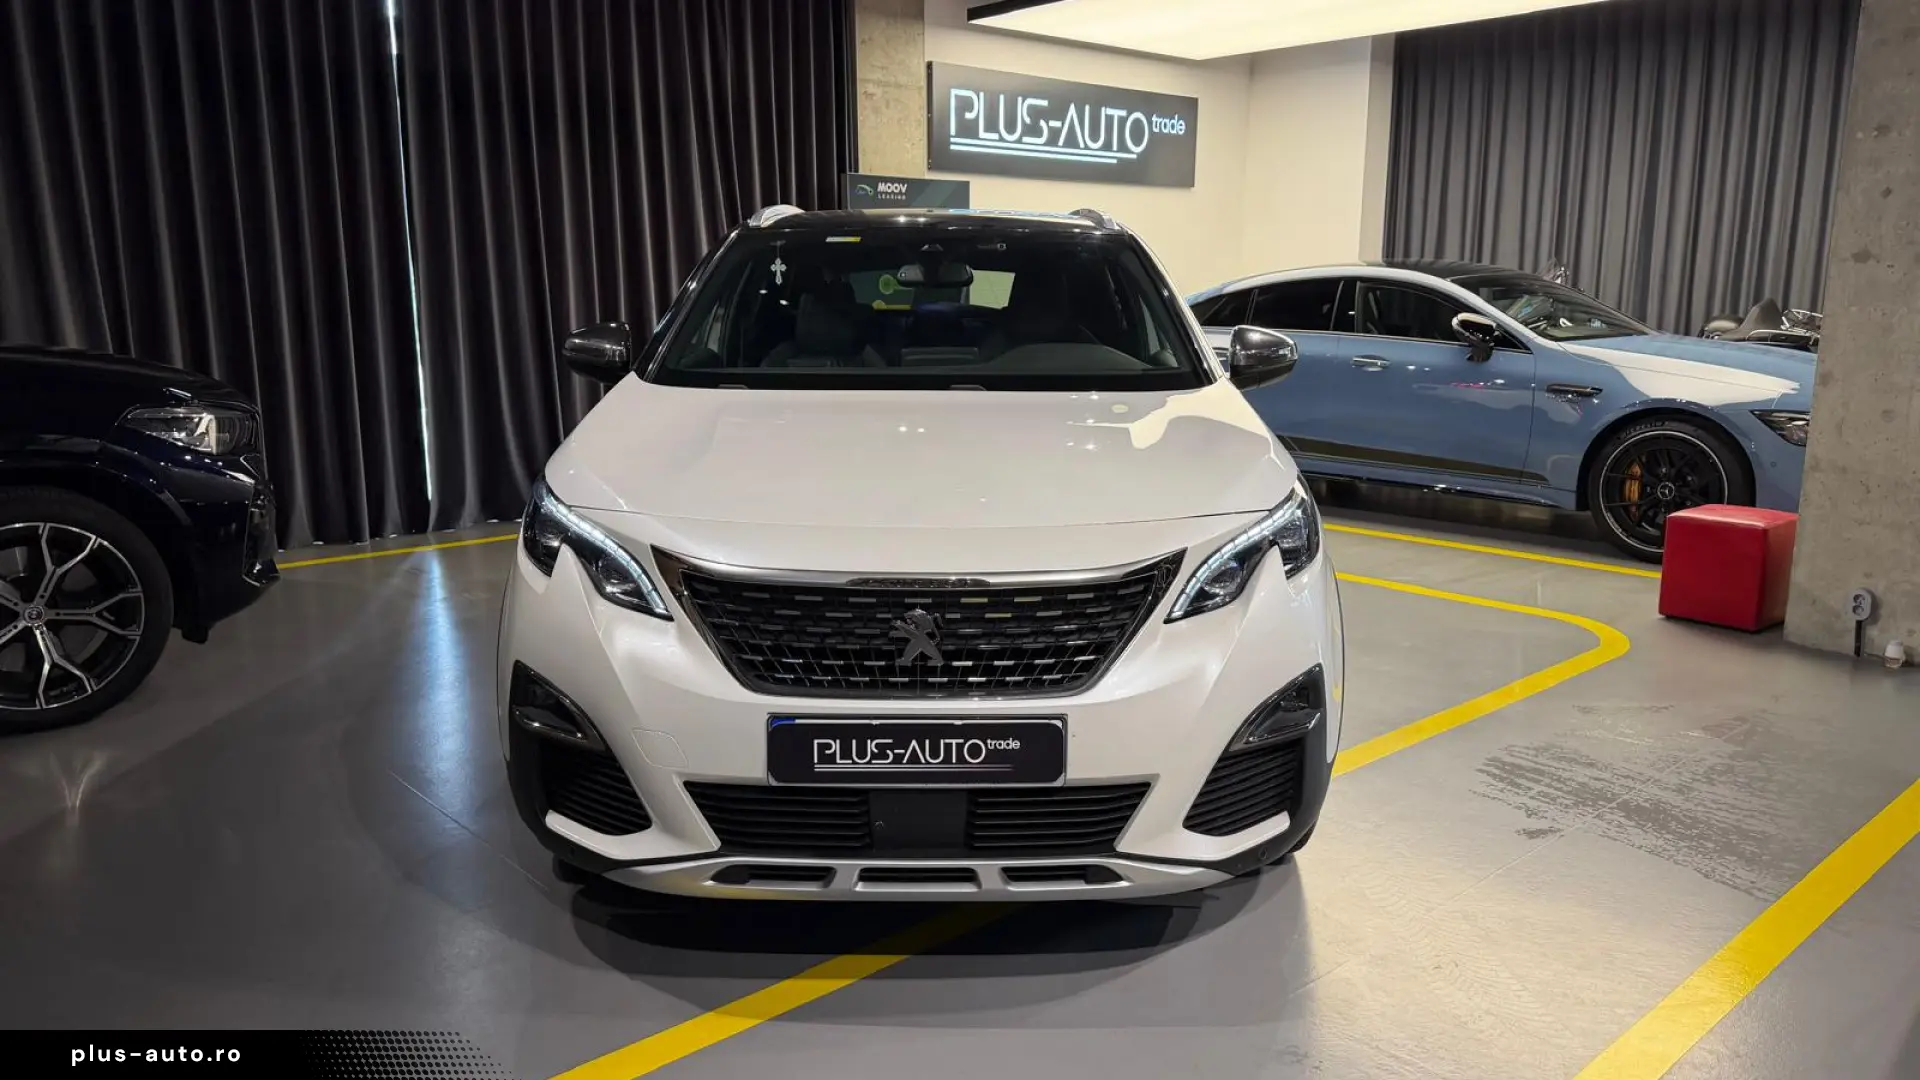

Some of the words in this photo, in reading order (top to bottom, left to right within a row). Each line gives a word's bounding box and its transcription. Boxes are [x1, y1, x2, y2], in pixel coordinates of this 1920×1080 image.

[950, 88, 1149, 152] PLUS-AUTO
[1151, 114, 1186, 135] trade
[877, 182, 908, 193] MOOV
[813, 739, 986, 763] PLUS-AUTO
[987, 738, 1021, 750] trade
